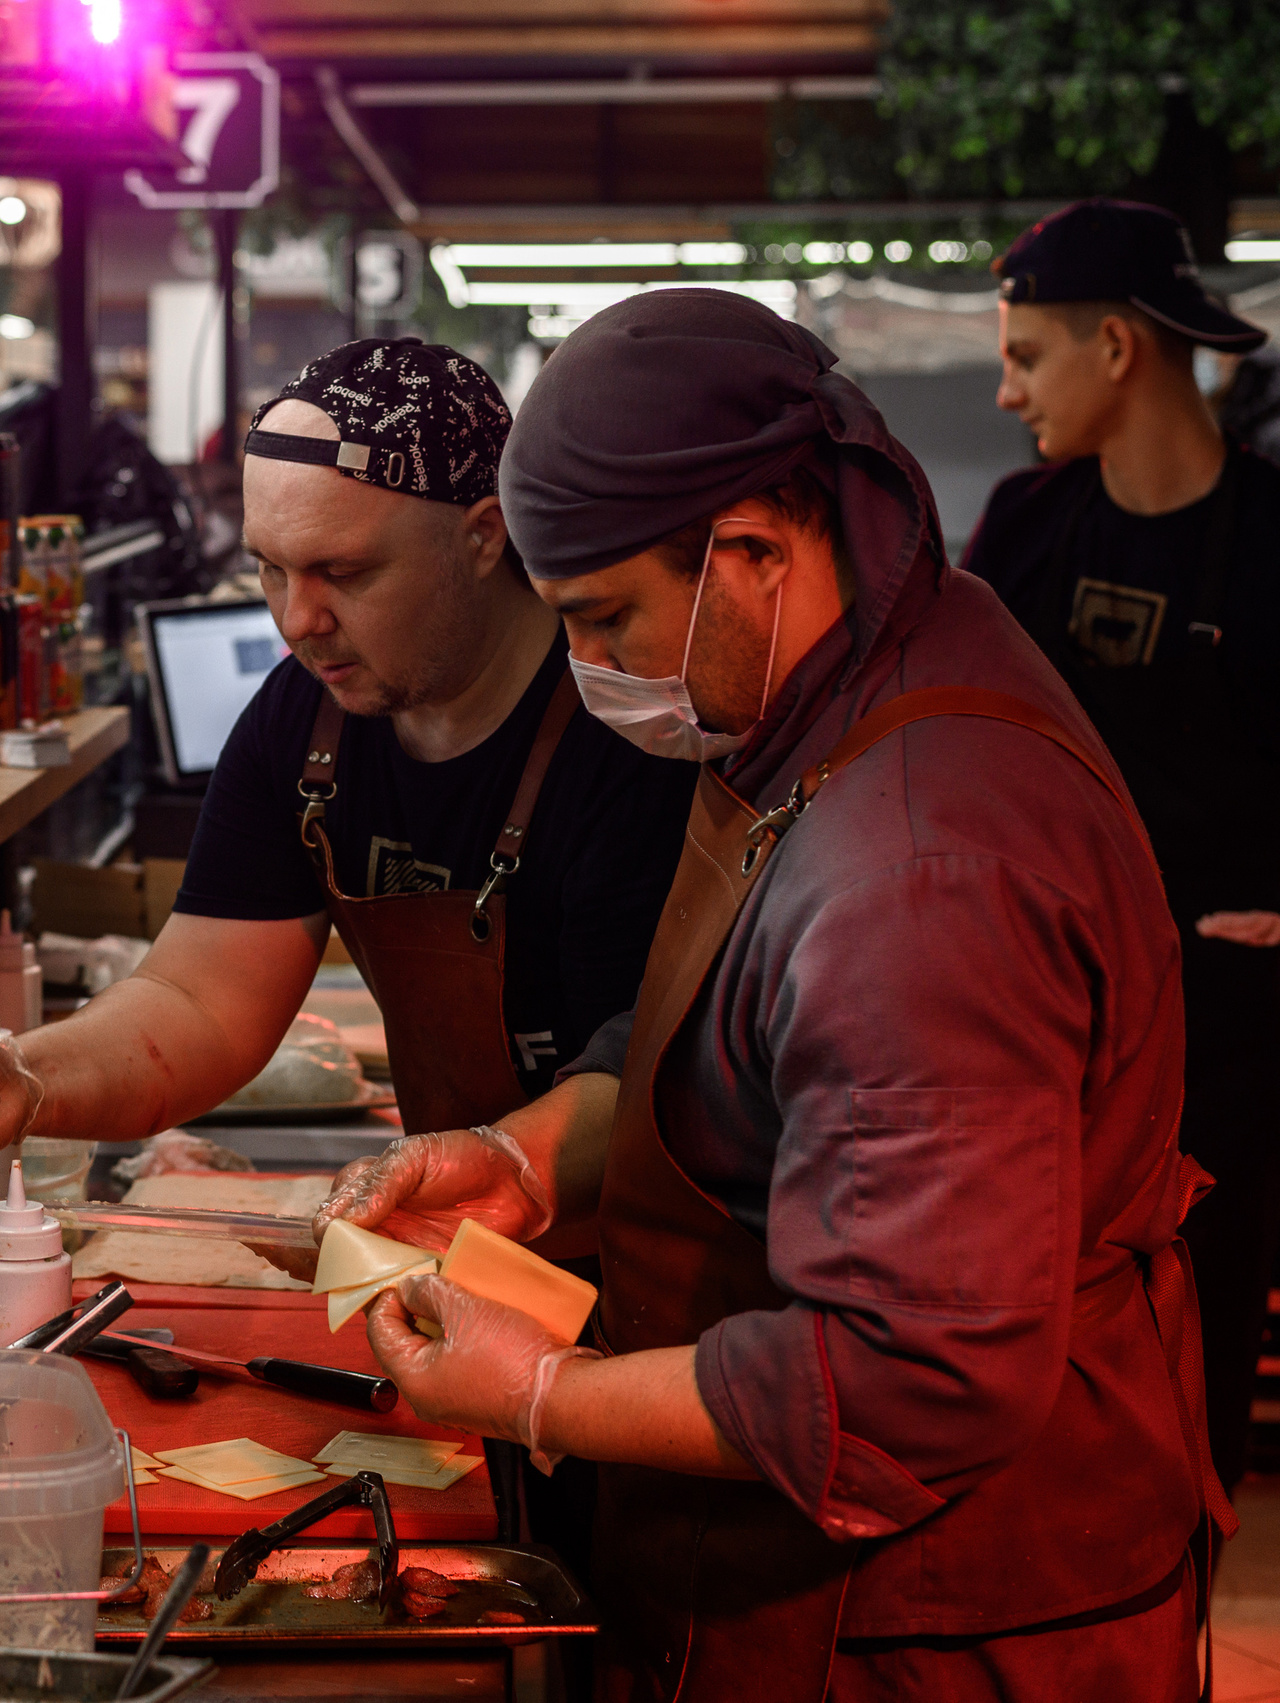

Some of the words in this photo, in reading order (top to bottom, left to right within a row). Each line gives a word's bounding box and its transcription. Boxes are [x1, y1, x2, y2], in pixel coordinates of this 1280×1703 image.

[172, 77, 241, 184] 7
[326, 384, 373, 407] Reebok
[370, 402, 415, 434] Reebok
[448, 449, 479, 485] Reebok
